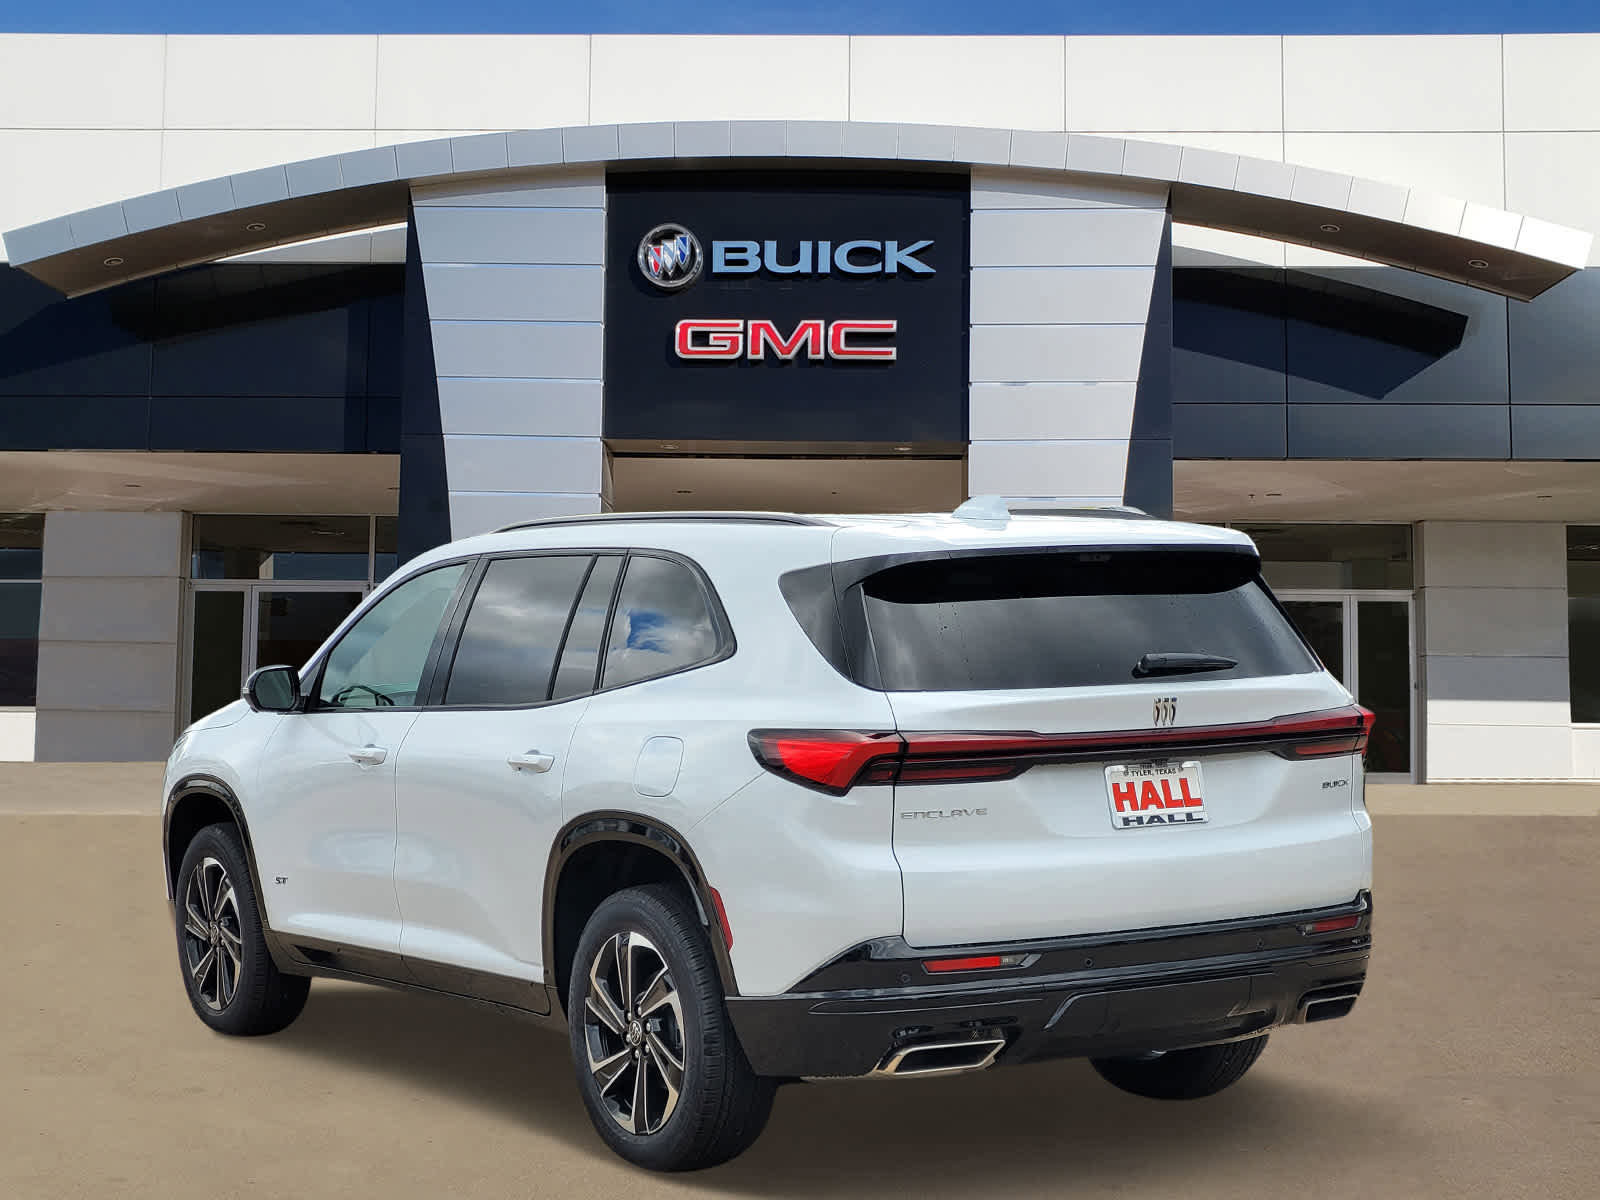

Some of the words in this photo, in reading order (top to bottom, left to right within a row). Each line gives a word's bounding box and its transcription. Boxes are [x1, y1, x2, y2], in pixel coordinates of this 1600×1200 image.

[711, 240, 937, 274] BUICK
[674, 319, 898, 361] GMC
[1112, 778, 1202, 812] HALL
[901, 808, 988, 819] ENCLAVE
[1122, 813, 1203, 826] HALL
